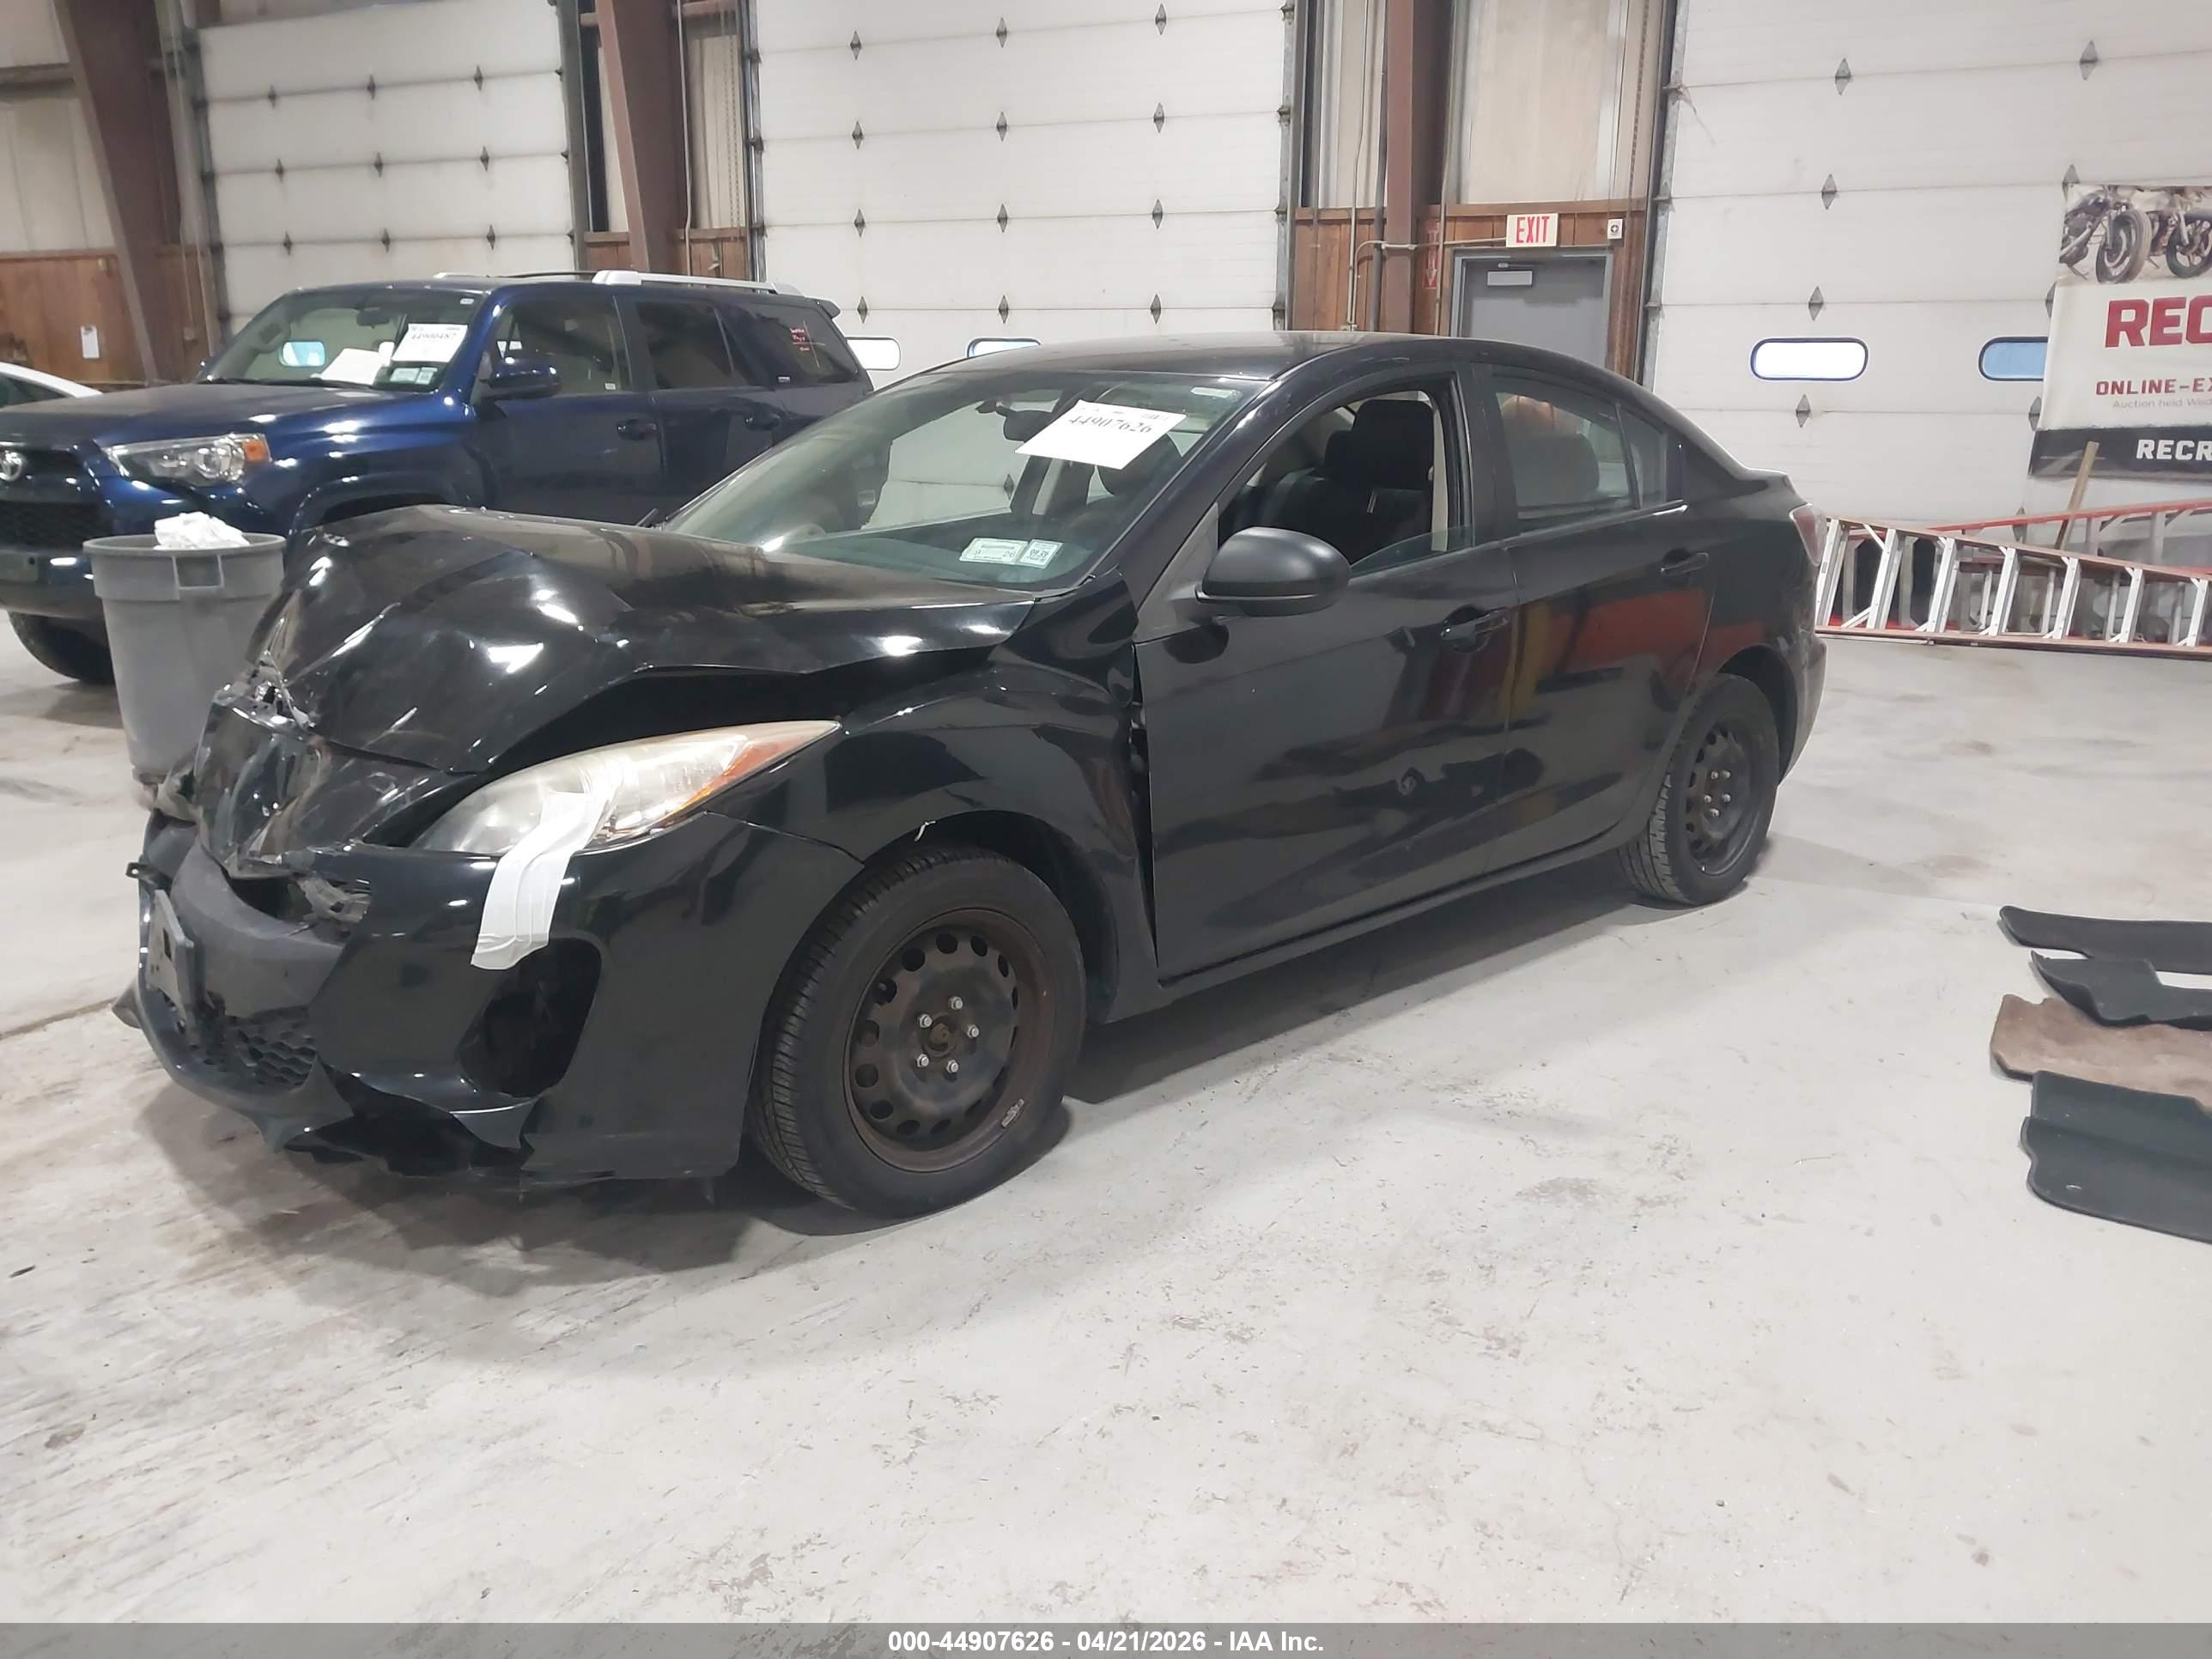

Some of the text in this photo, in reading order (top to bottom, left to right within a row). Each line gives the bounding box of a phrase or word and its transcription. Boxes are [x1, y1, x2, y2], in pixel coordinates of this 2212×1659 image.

[1516, 216, 1550, 244] EXIT
[2112, 399, 2155, 409] Auction
[2159, 398, 2183, 407] held
[1068, 415, 1152, 434] 44907626
[2136, 439, 2212, 461] RECR
